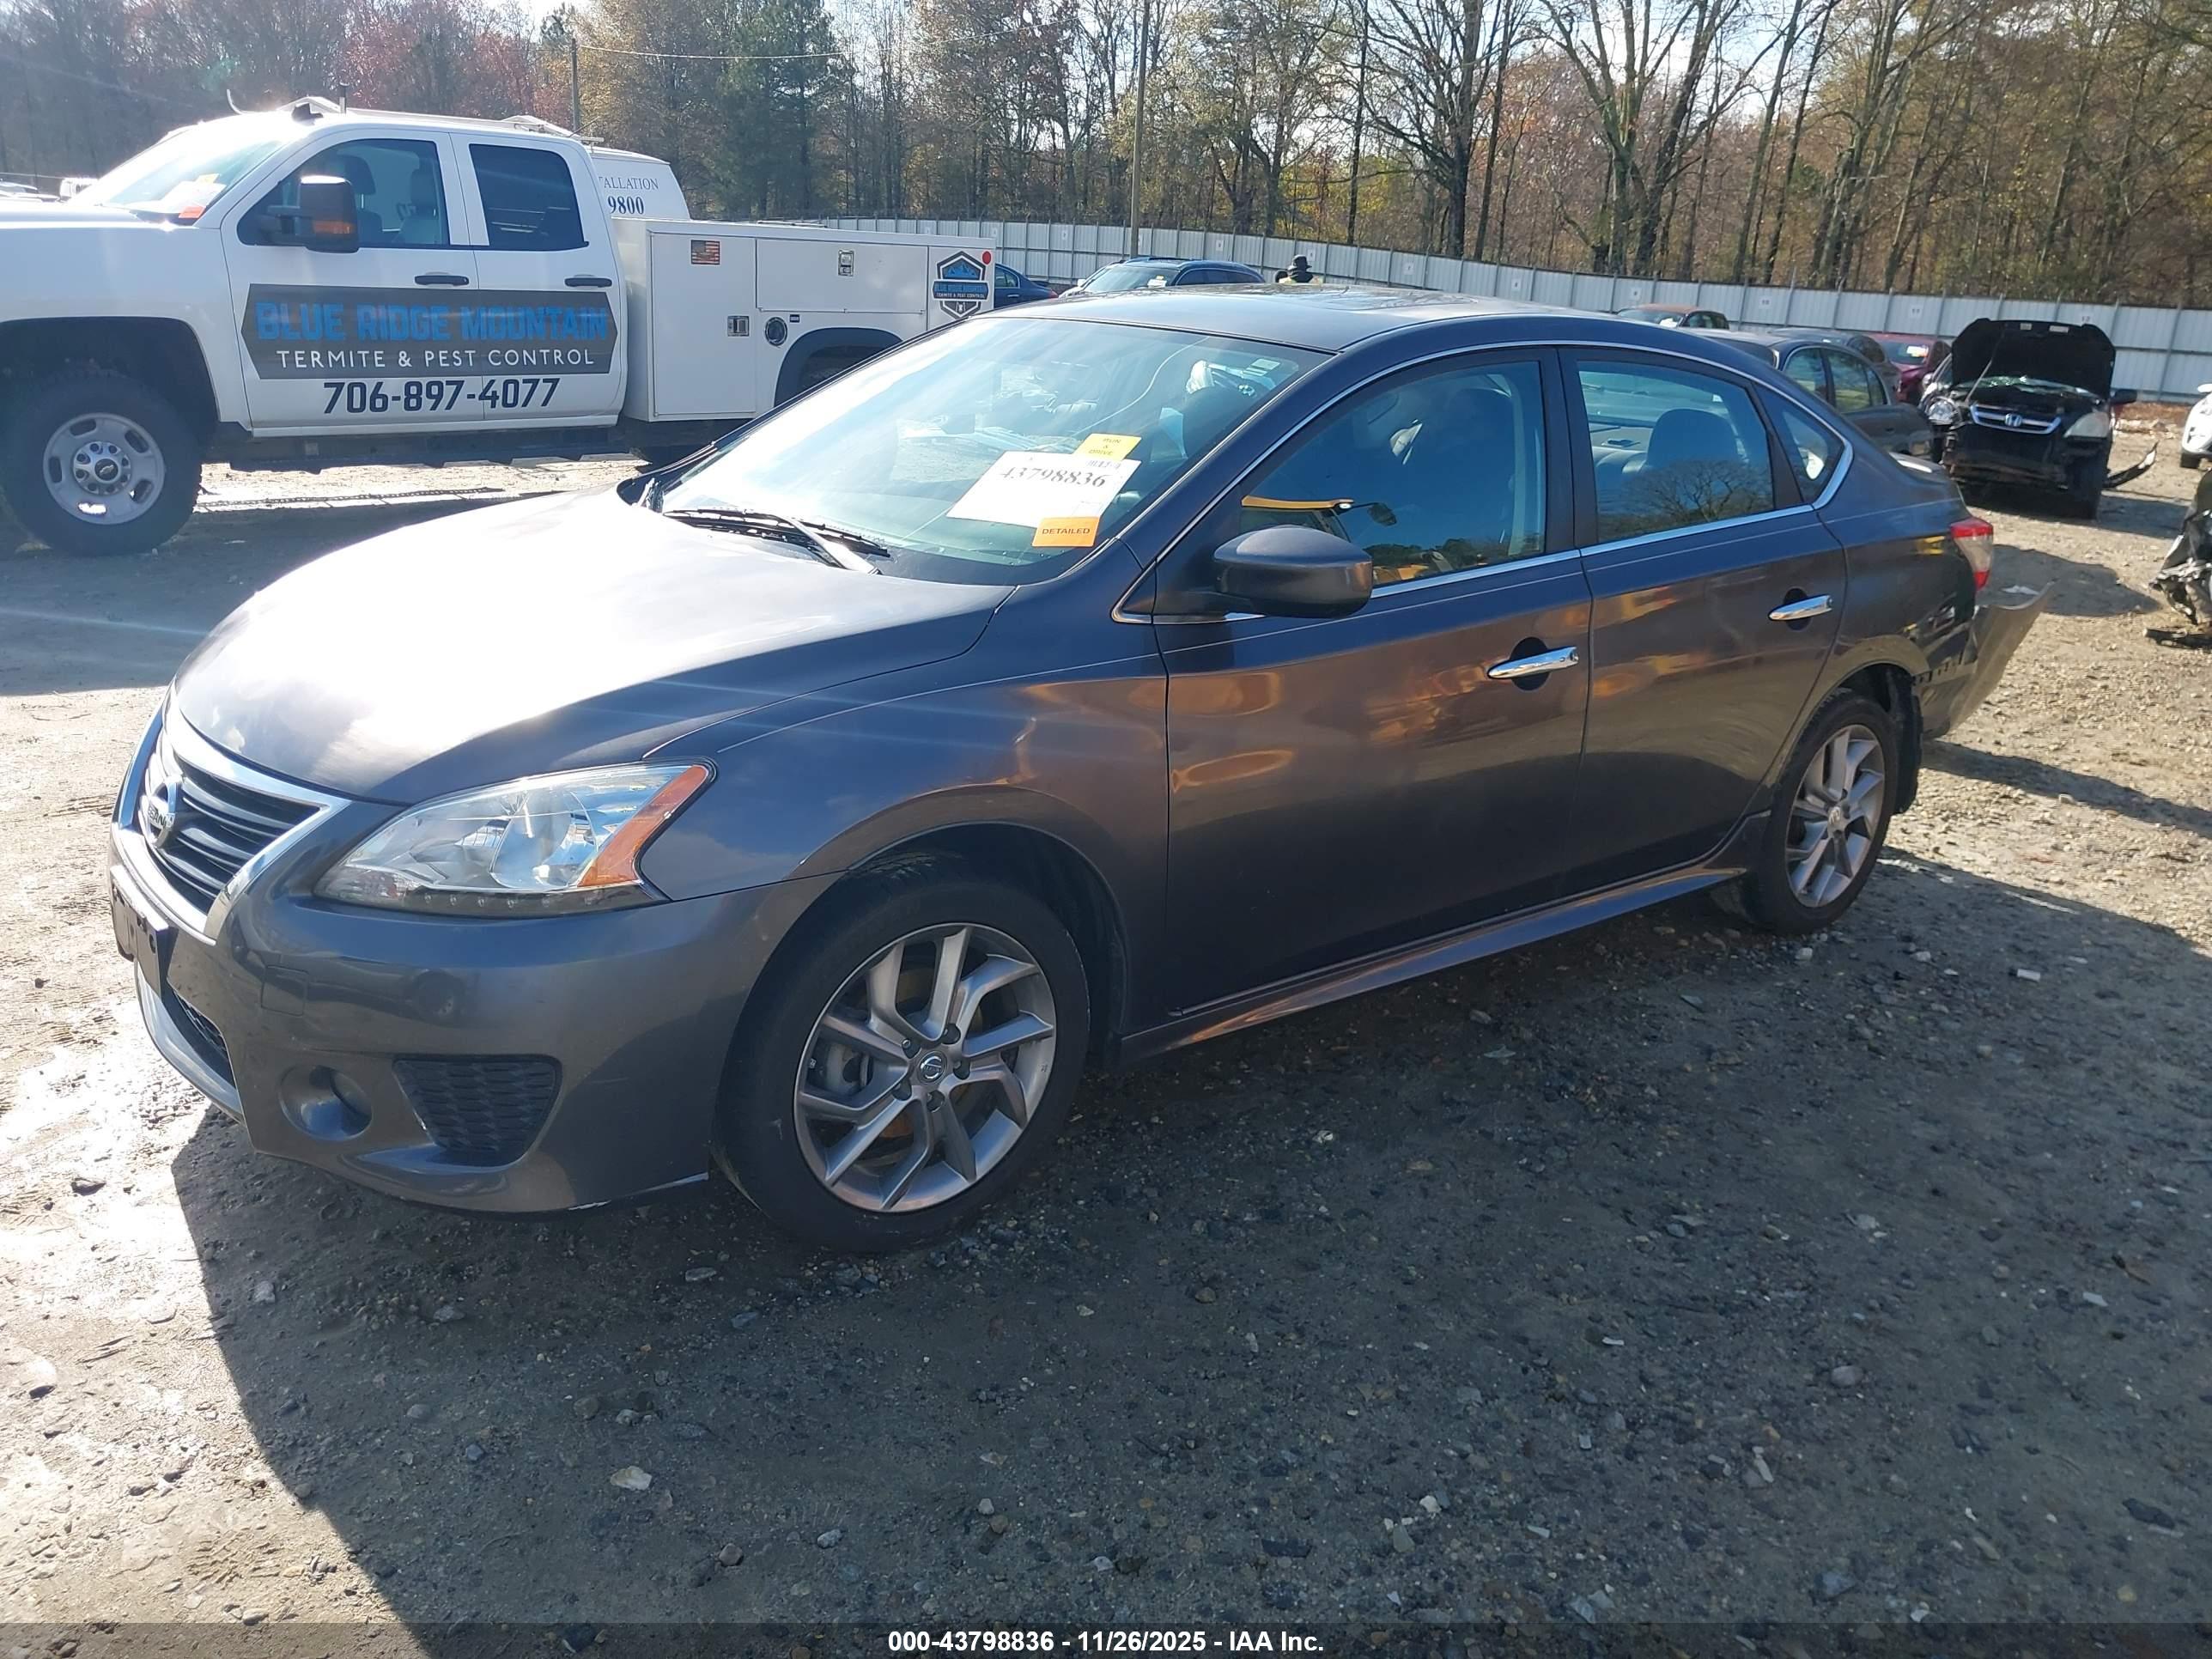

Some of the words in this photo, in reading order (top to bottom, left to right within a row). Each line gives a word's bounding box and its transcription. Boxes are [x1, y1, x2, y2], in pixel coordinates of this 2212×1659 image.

[607, 195, 645, 215] 9800
[257, 303, 345, 340] BLUE
[356, 303, 451, 341] RIDGE
[460, 304, 607, 342] MOUNTAIN
[276, 349, 386, 368] TERMITE
[398, 351, 412, 368] &
[425, 350, 477, 367] PEST
[488, 349, 595, 366] CONTROL
[323, 378, 561, 414] 706-897-4077
[1000, 466, 1111, 488] 43798836
[1042, 527, 1091, 536] DETAILED
